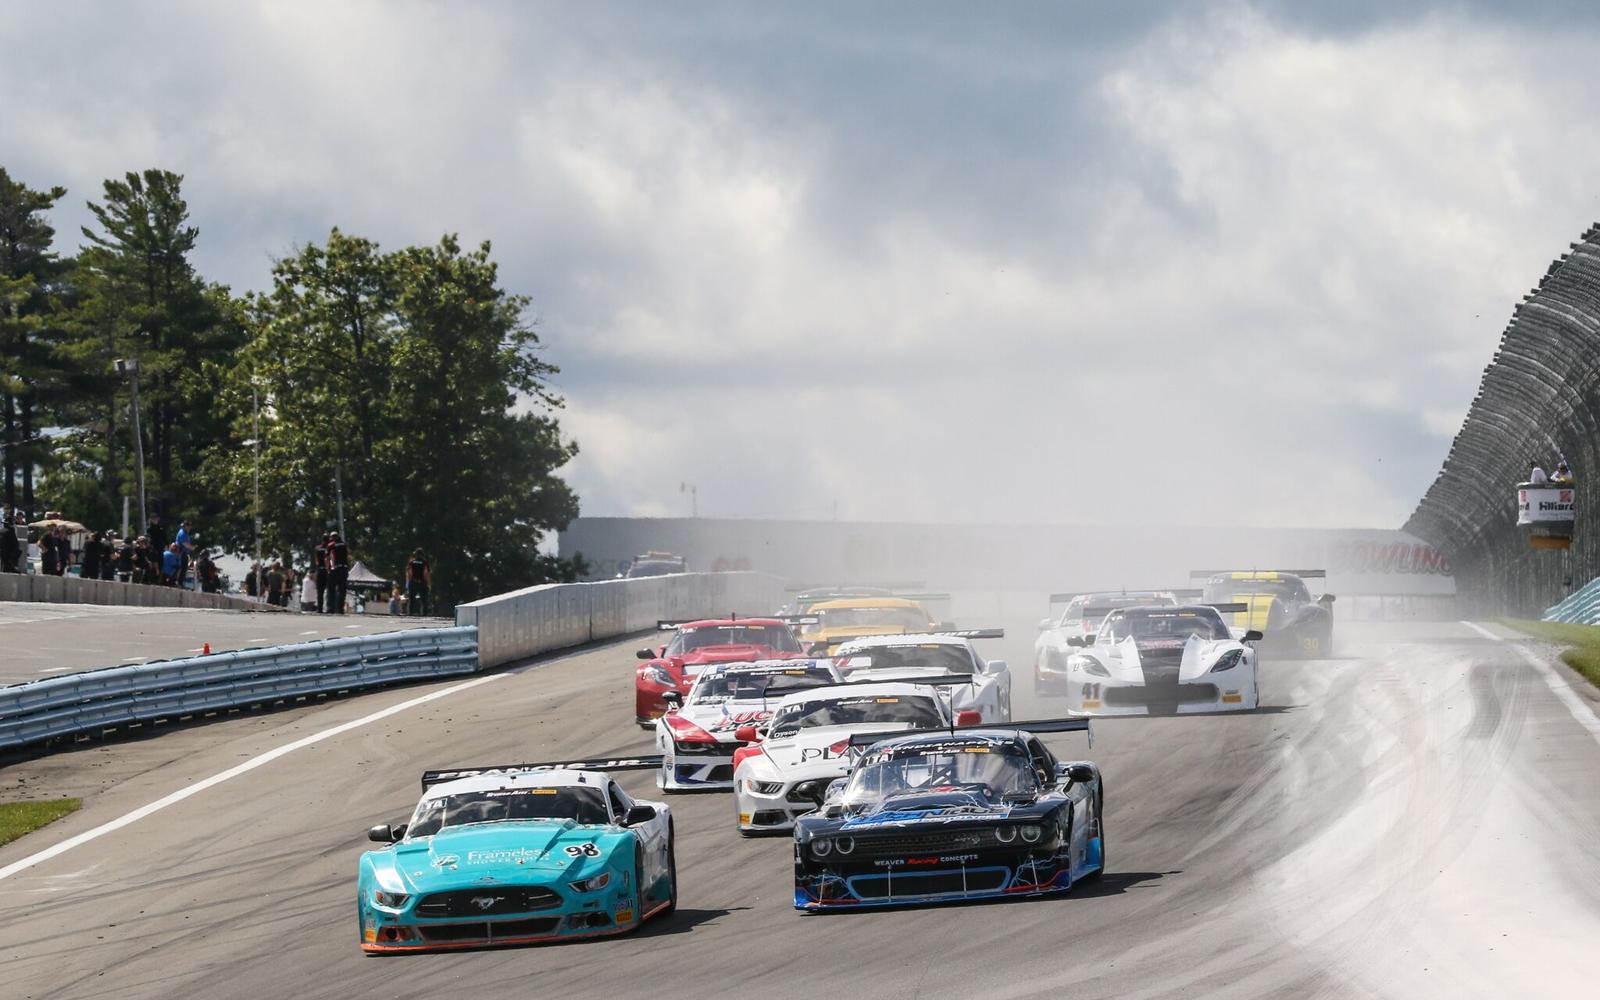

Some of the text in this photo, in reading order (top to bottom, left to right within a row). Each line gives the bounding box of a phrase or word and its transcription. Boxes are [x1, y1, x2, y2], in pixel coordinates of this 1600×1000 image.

[1082, 682, 1100, 699] 41
[786, 704, 803, 713] TA
[774, 730, 798, 739] Dyson
[467, 848, 550, 861] Frameless
[564, 843, 600, 857] 98
[940, 855, 979, 863] CONCEPTS
